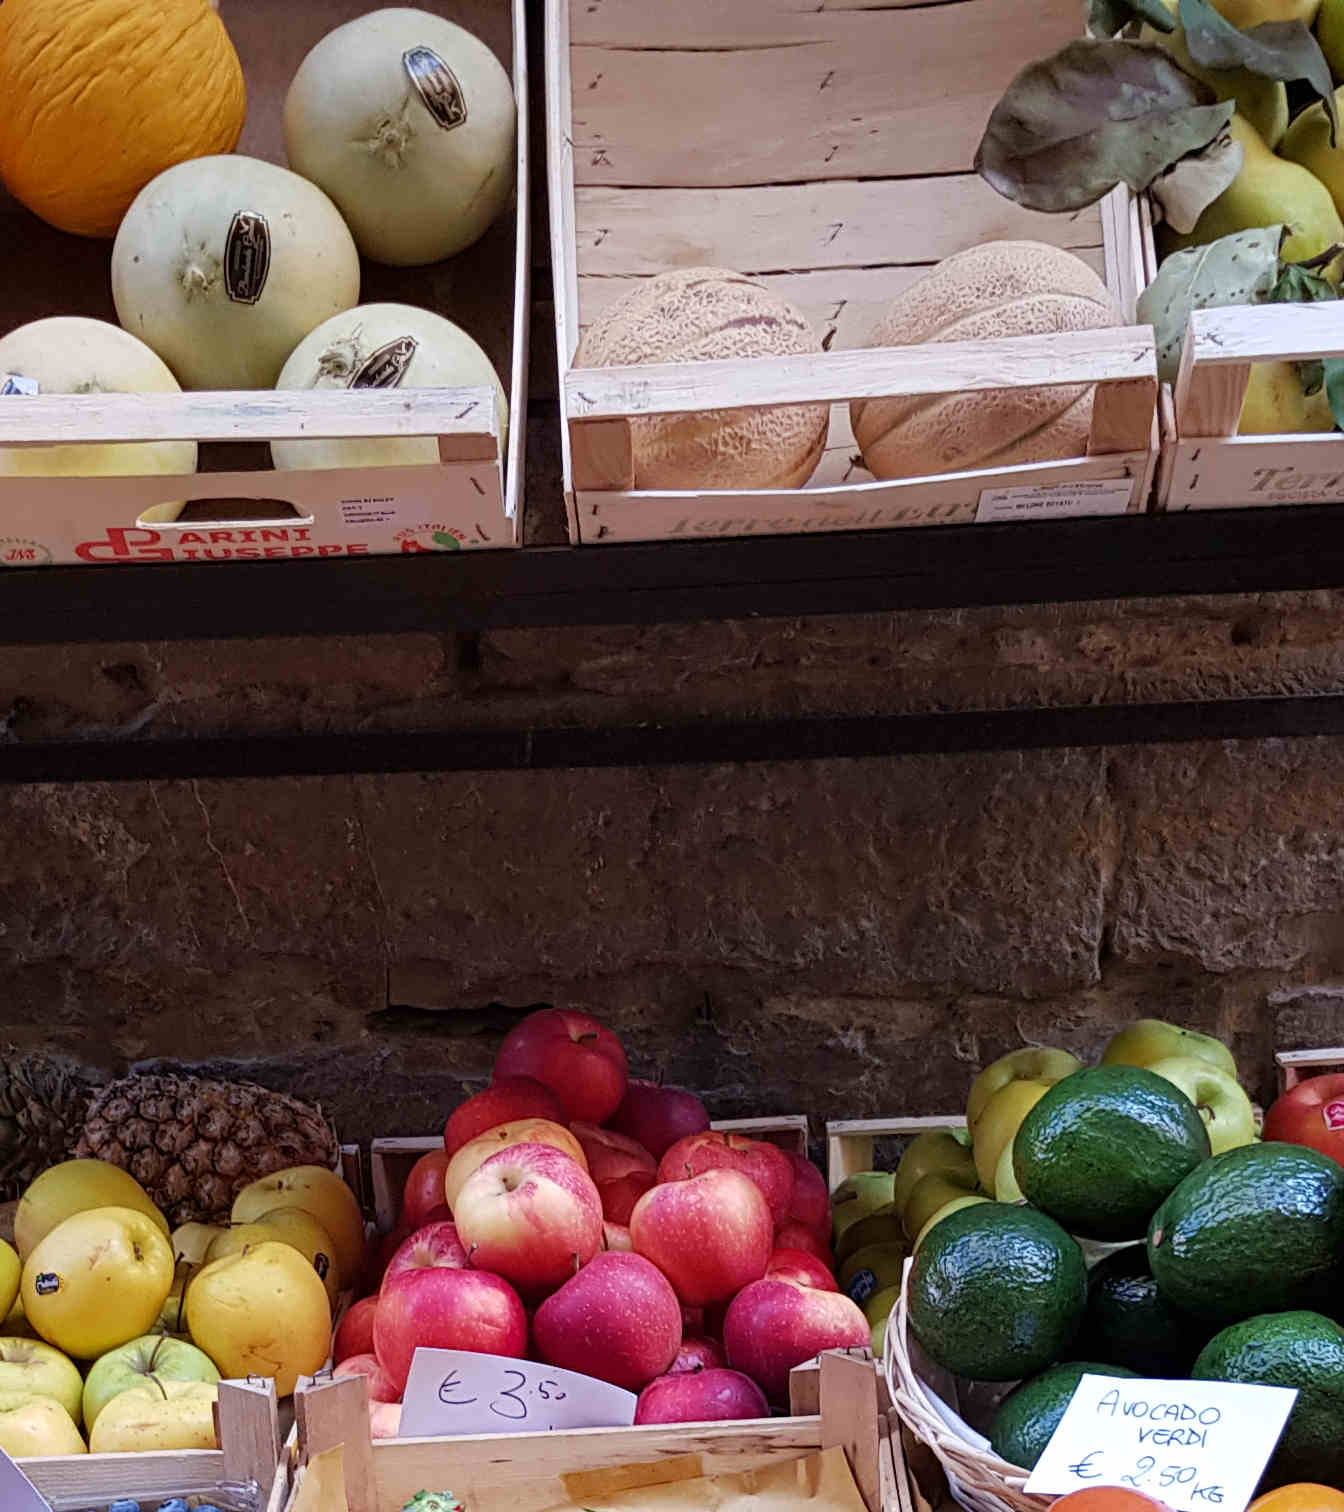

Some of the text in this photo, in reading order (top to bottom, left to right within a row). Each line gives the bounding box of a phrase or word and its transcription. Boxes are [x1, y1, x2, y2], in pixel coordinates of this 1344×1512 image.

[438, 1370, 478, 1405] €
[1096, 1389, 1222, 1426] AVOCADO
[1138, 1427, 1209, 1449] VERDI
[1067, 1450, 1105, 1480] €
[1120, 1455, 1197, 1488] 2.50
